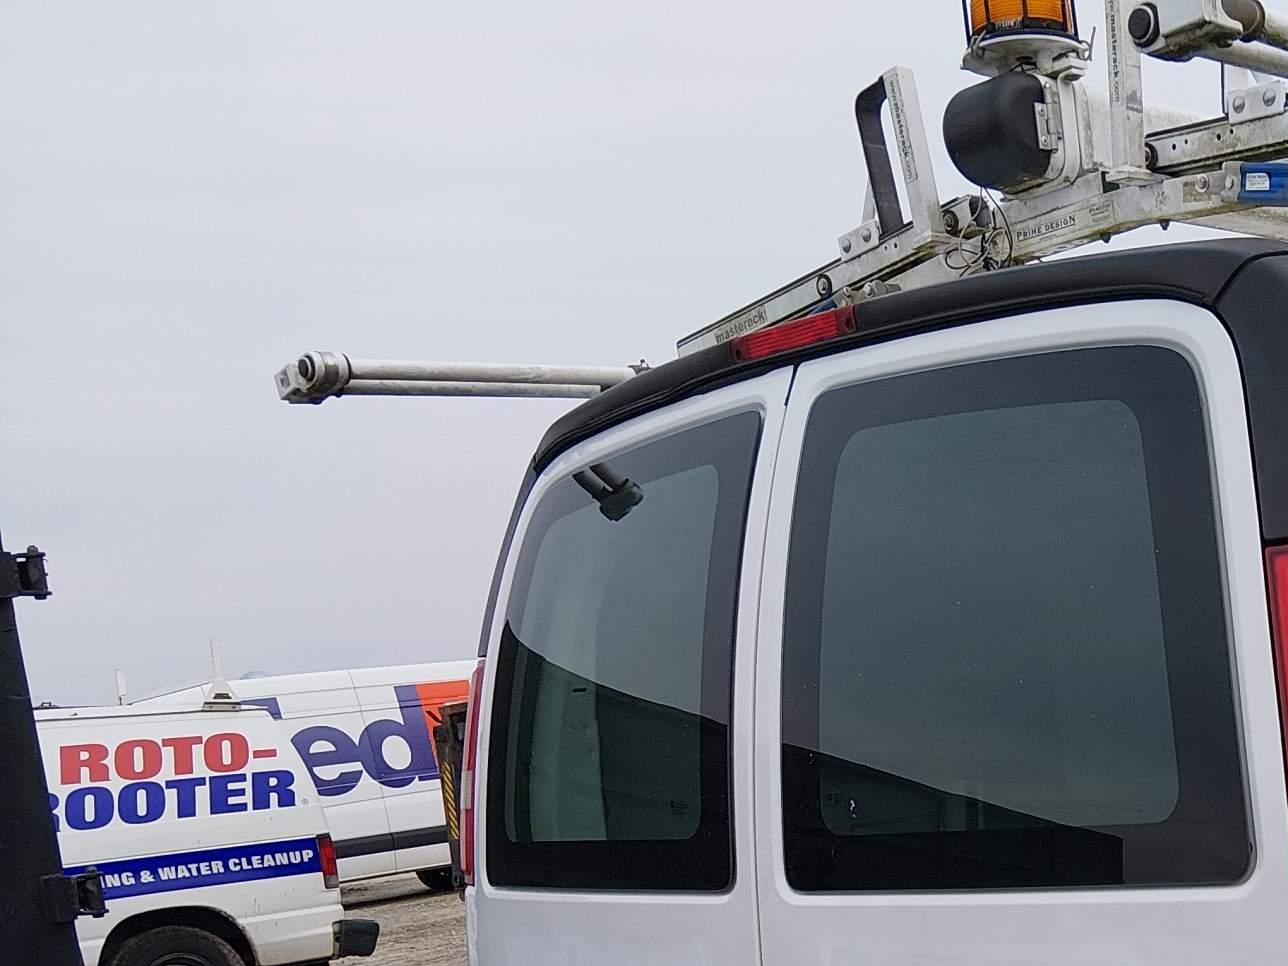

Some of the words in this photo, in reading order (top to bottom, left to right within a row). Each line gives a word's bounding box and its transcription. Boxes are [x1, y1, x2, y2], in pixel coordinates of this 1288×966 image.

[1044, 214, 1076, 231] DESIGN
[59, 732, 278, 786] ROTO-
[100, 872, 136, 889] ING
[140, 870, 155, 883] &
[157, 864, 225, 881] WATER
[228, 849, 314, 872] CLEANUP
